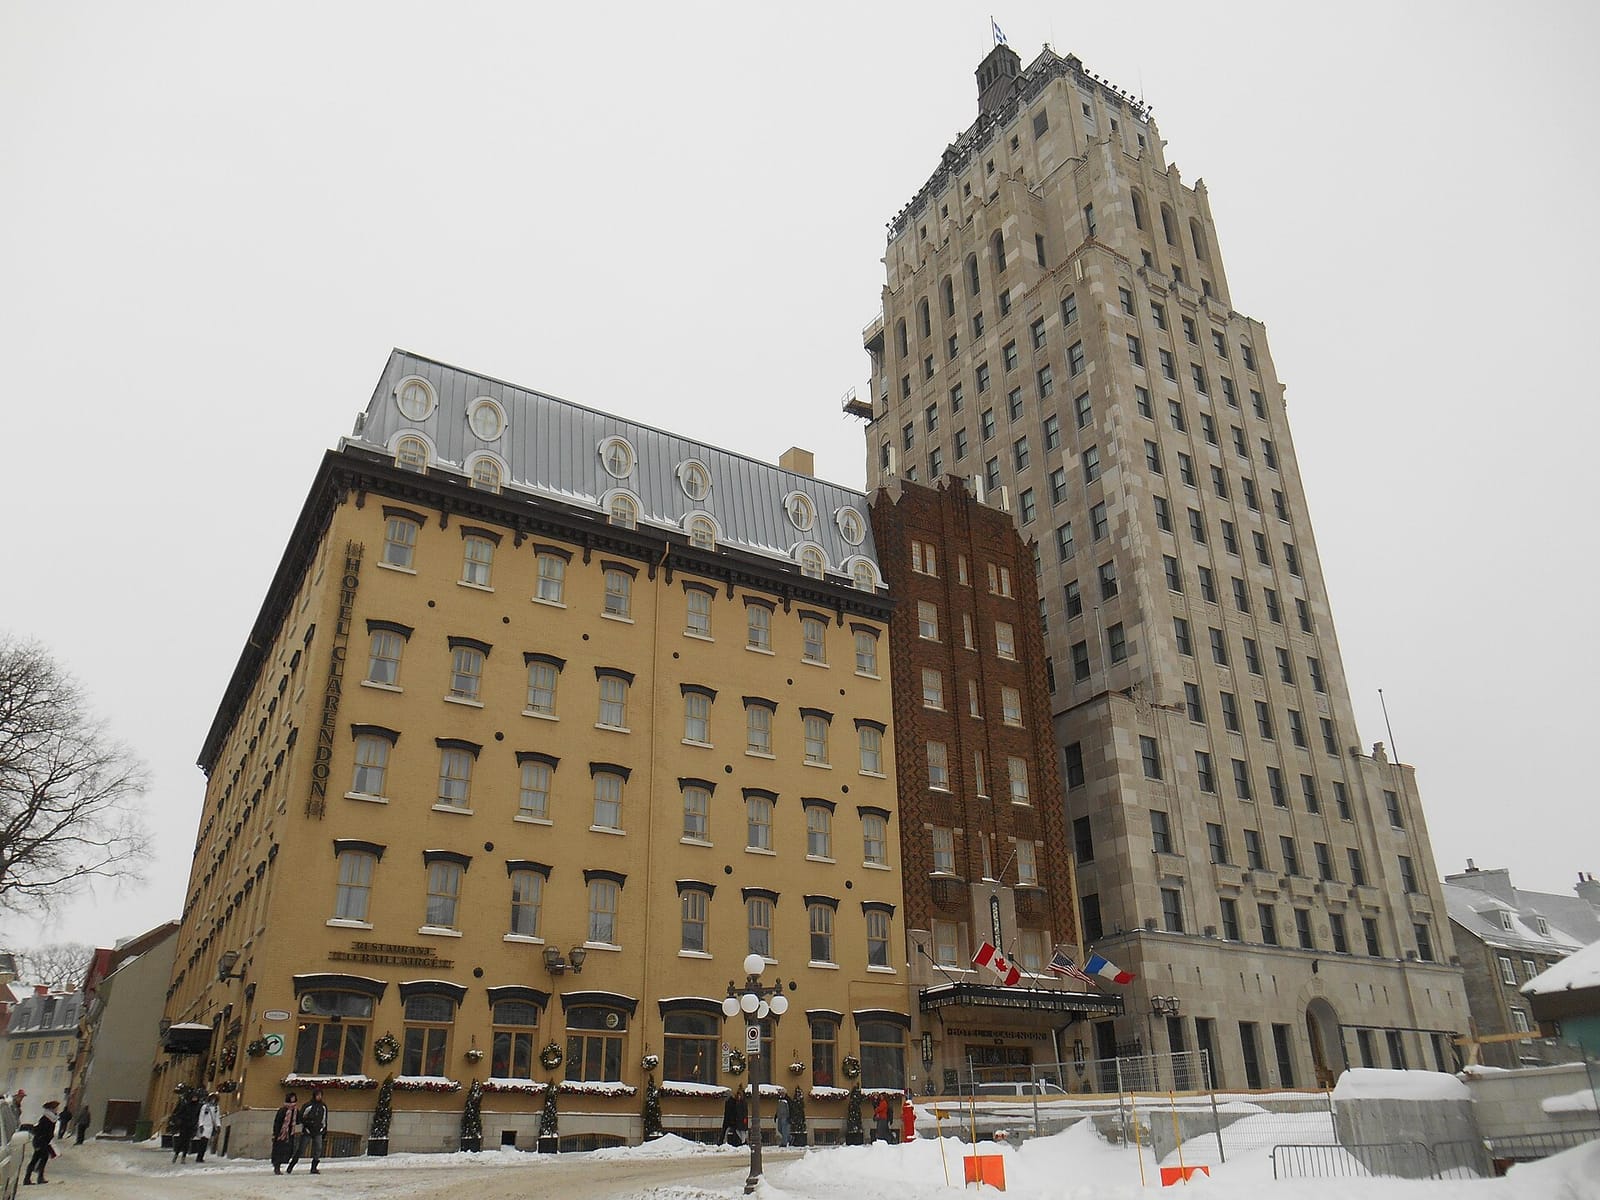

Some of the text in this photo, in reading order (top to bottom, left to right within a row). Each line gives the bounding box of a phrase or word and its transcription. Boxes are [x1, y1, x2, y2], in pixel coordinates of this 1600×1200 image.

[310, 557, 361, 797] HOTEL CLARENDON
[356, 942, 432, 955] RESTAURANT
